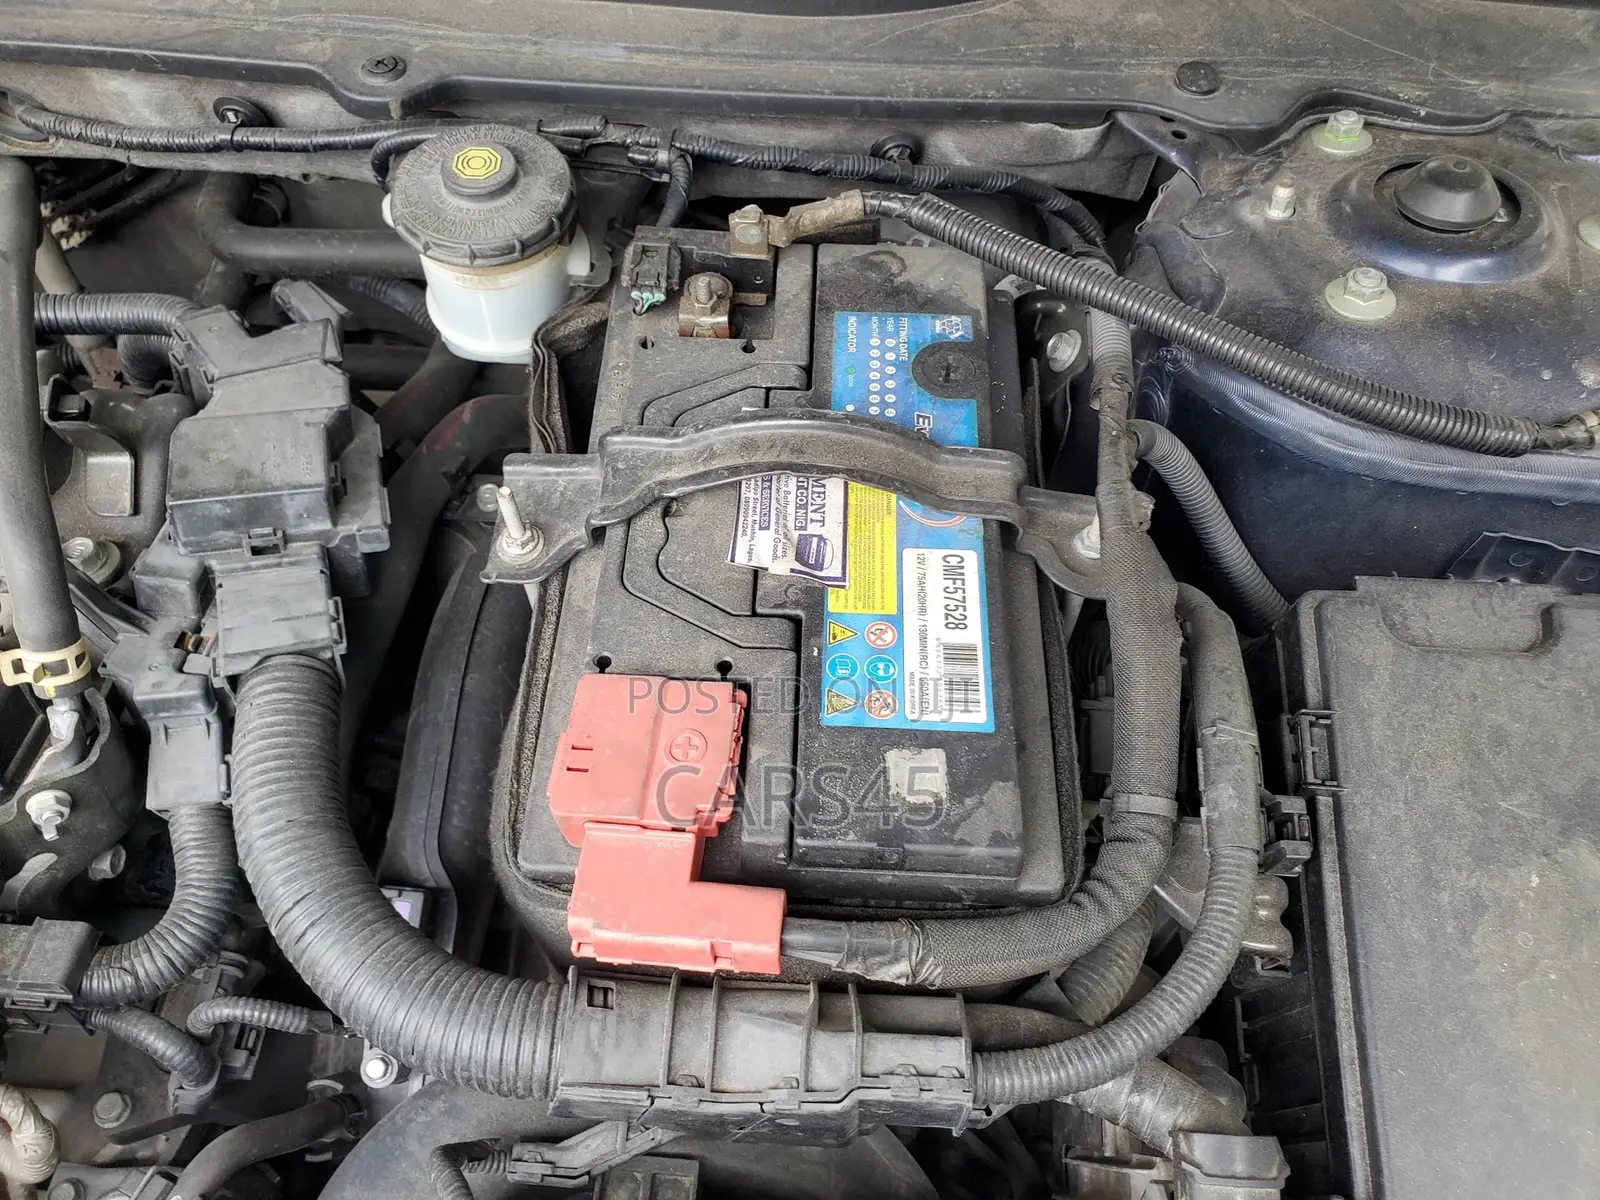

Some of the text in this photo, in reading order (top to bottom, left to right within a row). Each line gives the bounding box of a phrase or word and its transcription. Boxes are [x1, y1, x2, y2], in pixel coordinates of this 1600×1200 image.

[847, 316, 856, 353] INDICATOR
[870, 316, 879, 336] MONTH
[886, 317, 894, 332] YEAR
[899, 317, 908, 361] FITTING DATE
[760, 488, 770, 528] SERVICES
[782, 490, 792, 524] Batteries
[796, 489, 807, 506] CO.
[773, 506, 782, 536] General
[795, 509, 807, 530] NIG.
[916, 553, 926, 565] 12V
[917, 571, 928, 616] 75AH(20HR)
[941, 554, 968, 630] CMF57528
[918, 624, 930, 670] 130MIN(RC)
